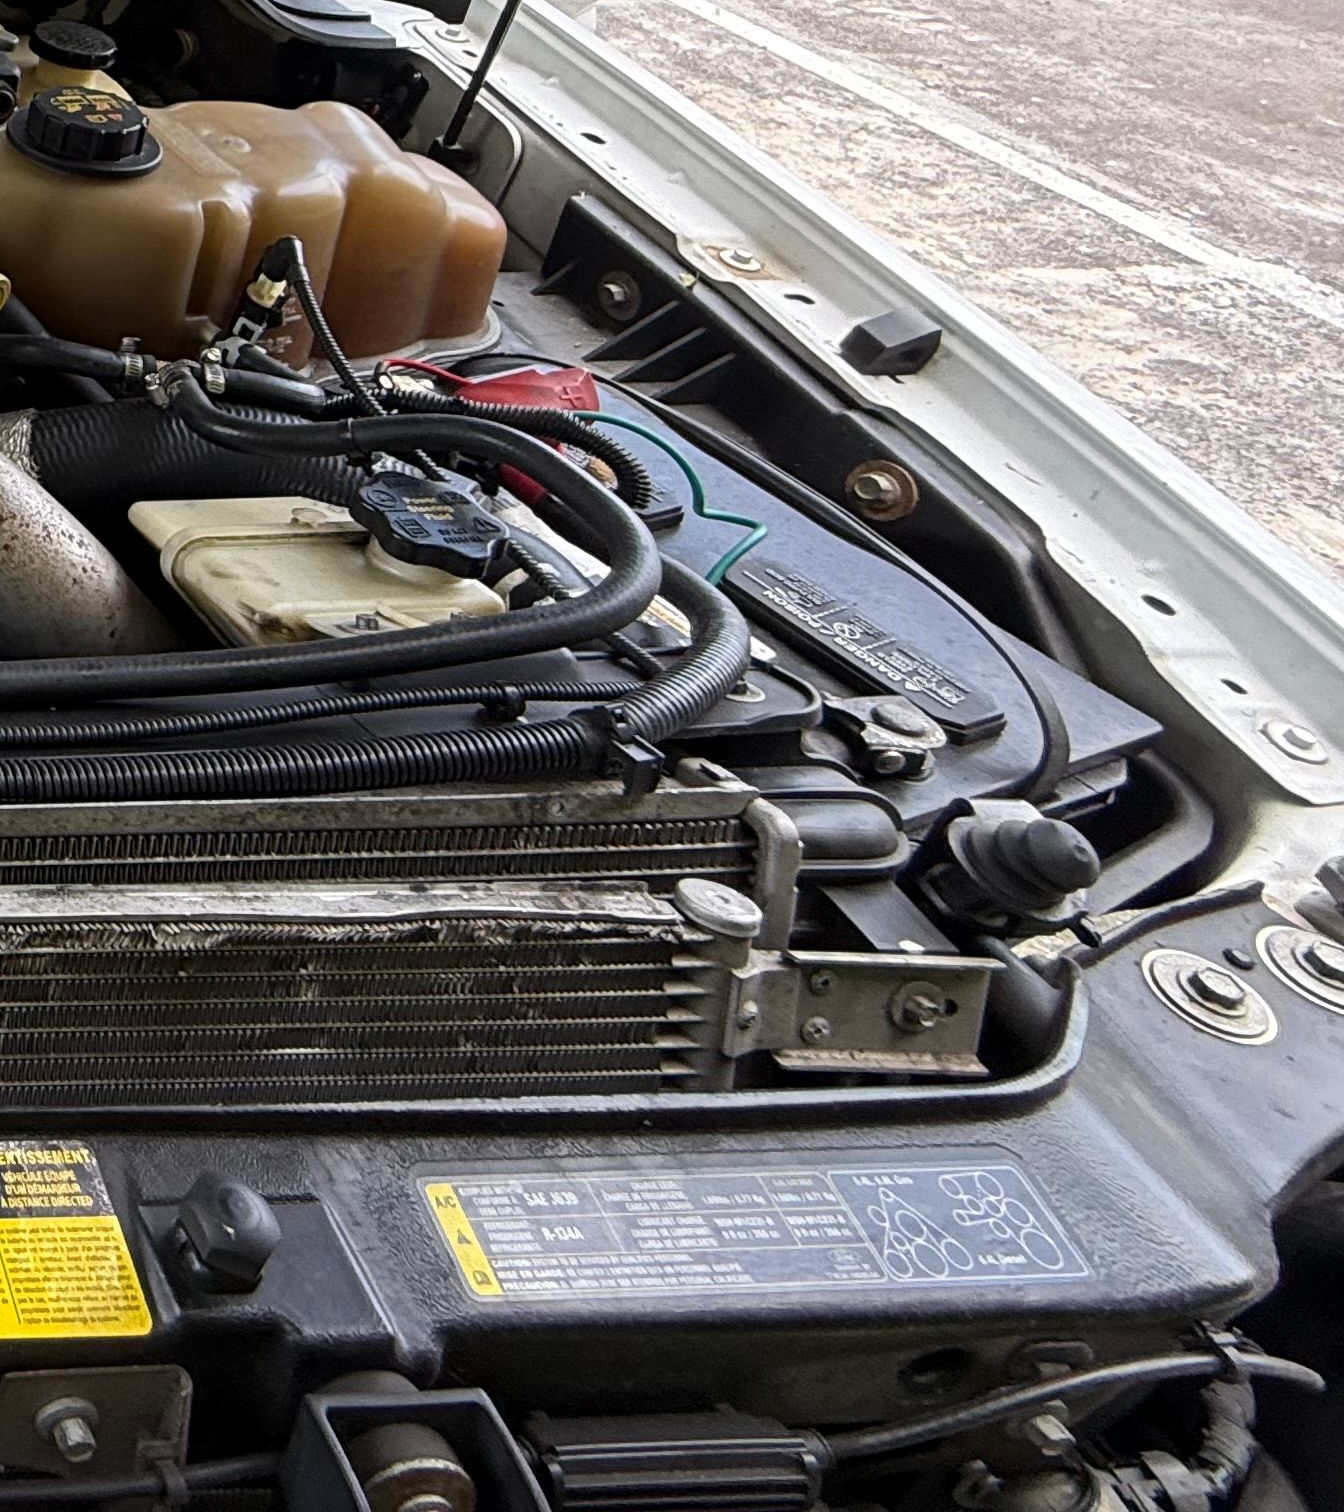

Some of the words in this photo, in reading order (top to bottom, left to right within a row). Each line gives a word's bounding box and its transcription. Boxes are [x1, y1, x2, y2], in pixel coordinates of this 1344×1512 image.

[762, 589, 824, 628] POISON
[833, 636, 904, 681] DANGER
[50, 1195, 94, 1207] DIRECTED
[434, 1195, 457, 1209] A/C
[522, 1192, 549, 1207] SAE
[551, 1191, 579, 1206] J639
[541, 1226, 585, 1242] R-134A
